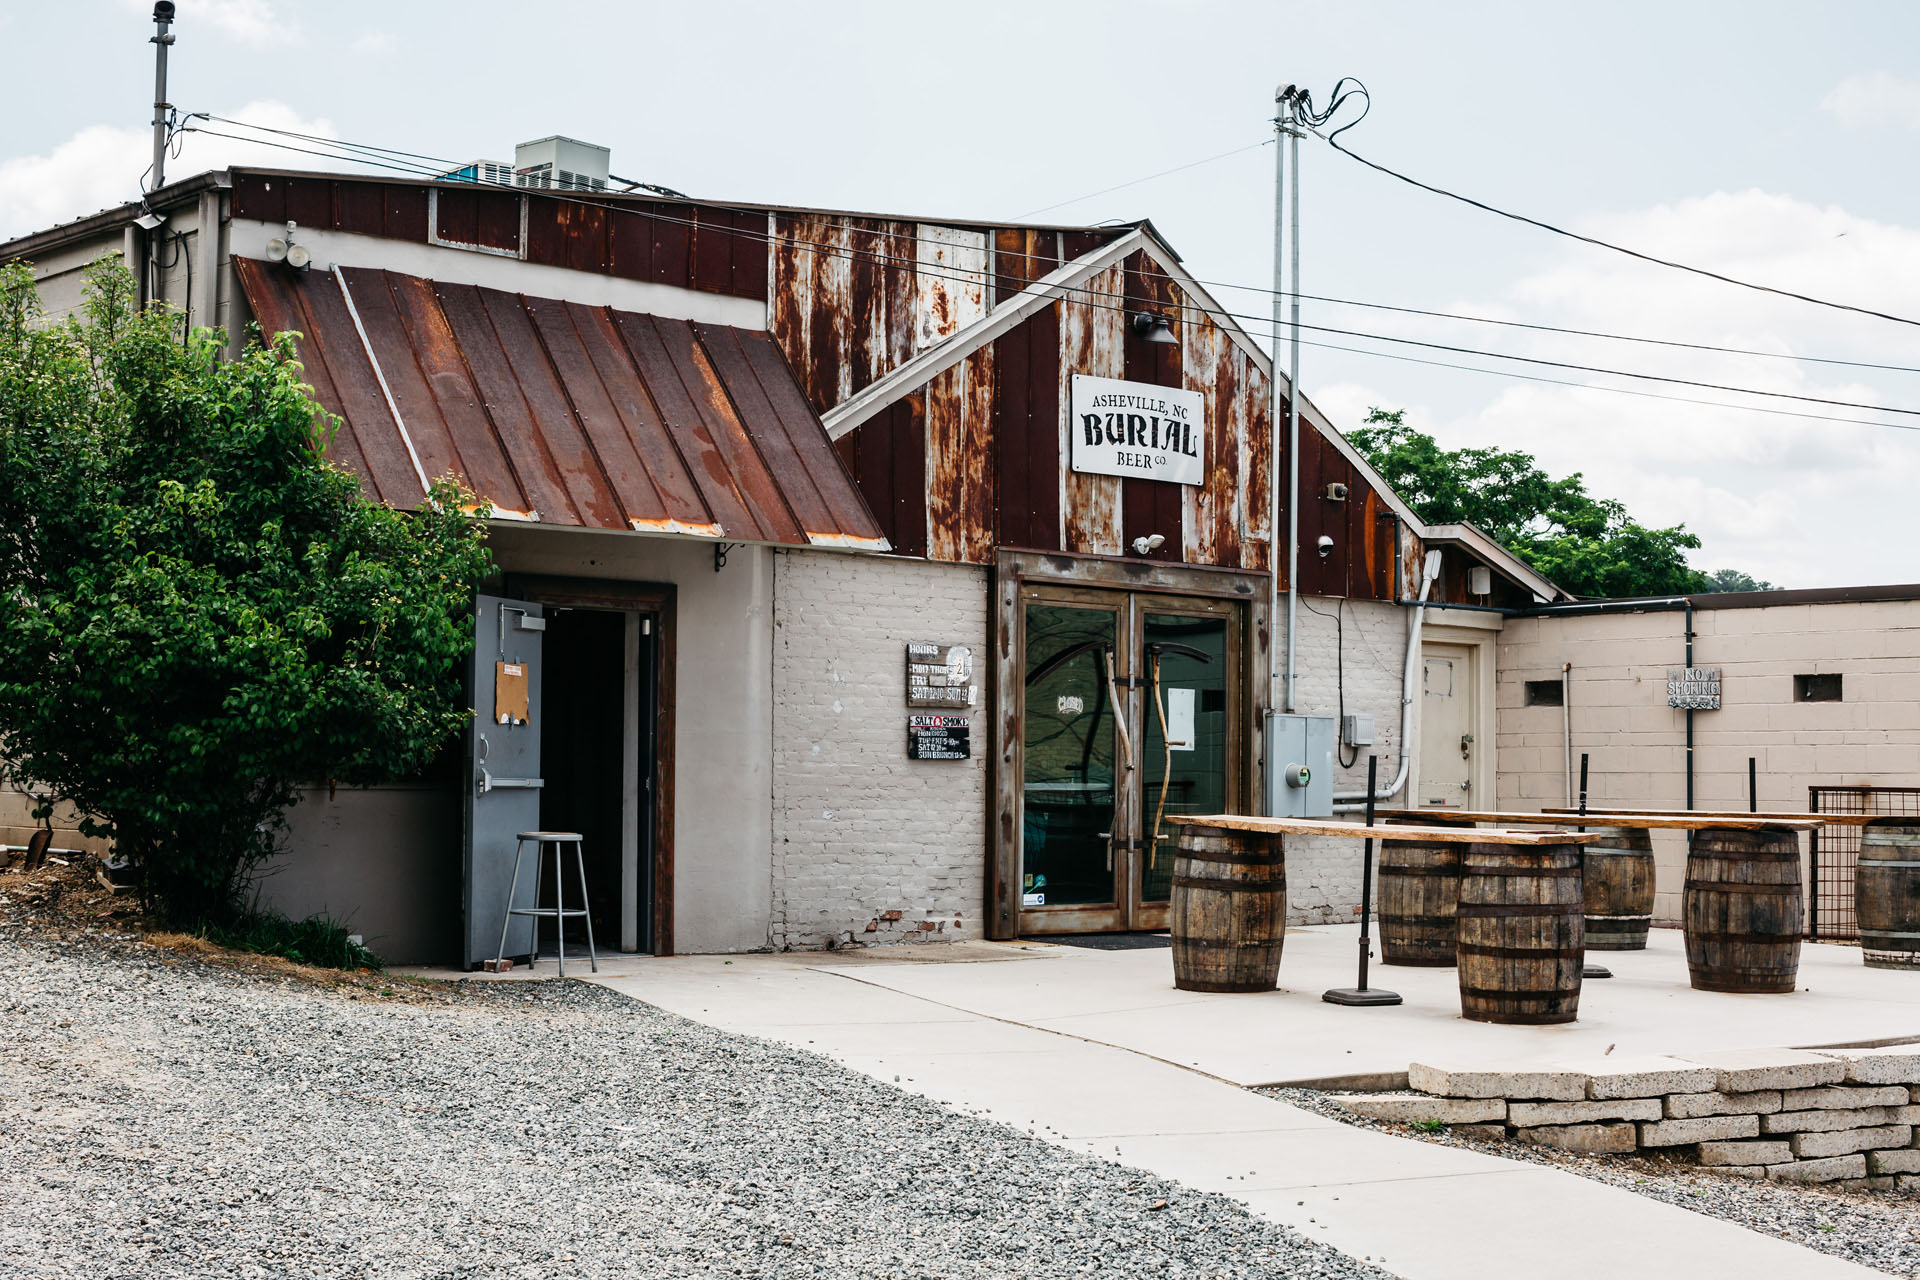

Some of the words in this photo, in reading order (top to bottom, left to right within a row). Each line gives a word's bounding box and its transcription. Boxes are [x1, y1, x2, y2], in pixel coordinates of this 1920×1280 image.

[1092, 395, 1169, 416] ASHEVILLE,
[1172, 404, 1188, 419] NC
[1080, 413, 1198, 458] BURIAL
[1117, 452, 1152, 469] BEER
[1154, 455, 1168, 465] CO.
[909, 644, 938, 655] HOURS
[912, 664, 928, 673] MON
[1684, 669, 1703, 681] NO
[912, 687, 928, 699] SAT
[947, 688, 961, 700] SUN
[1667, 681, 1720, 695] SMOKING
[915, 716, 933, 726] SALT
[942, 717, 969, 727] SMOKE
[918, 751, 932, 759] SUN
[932, 751, 955, 759] BRUNCH
